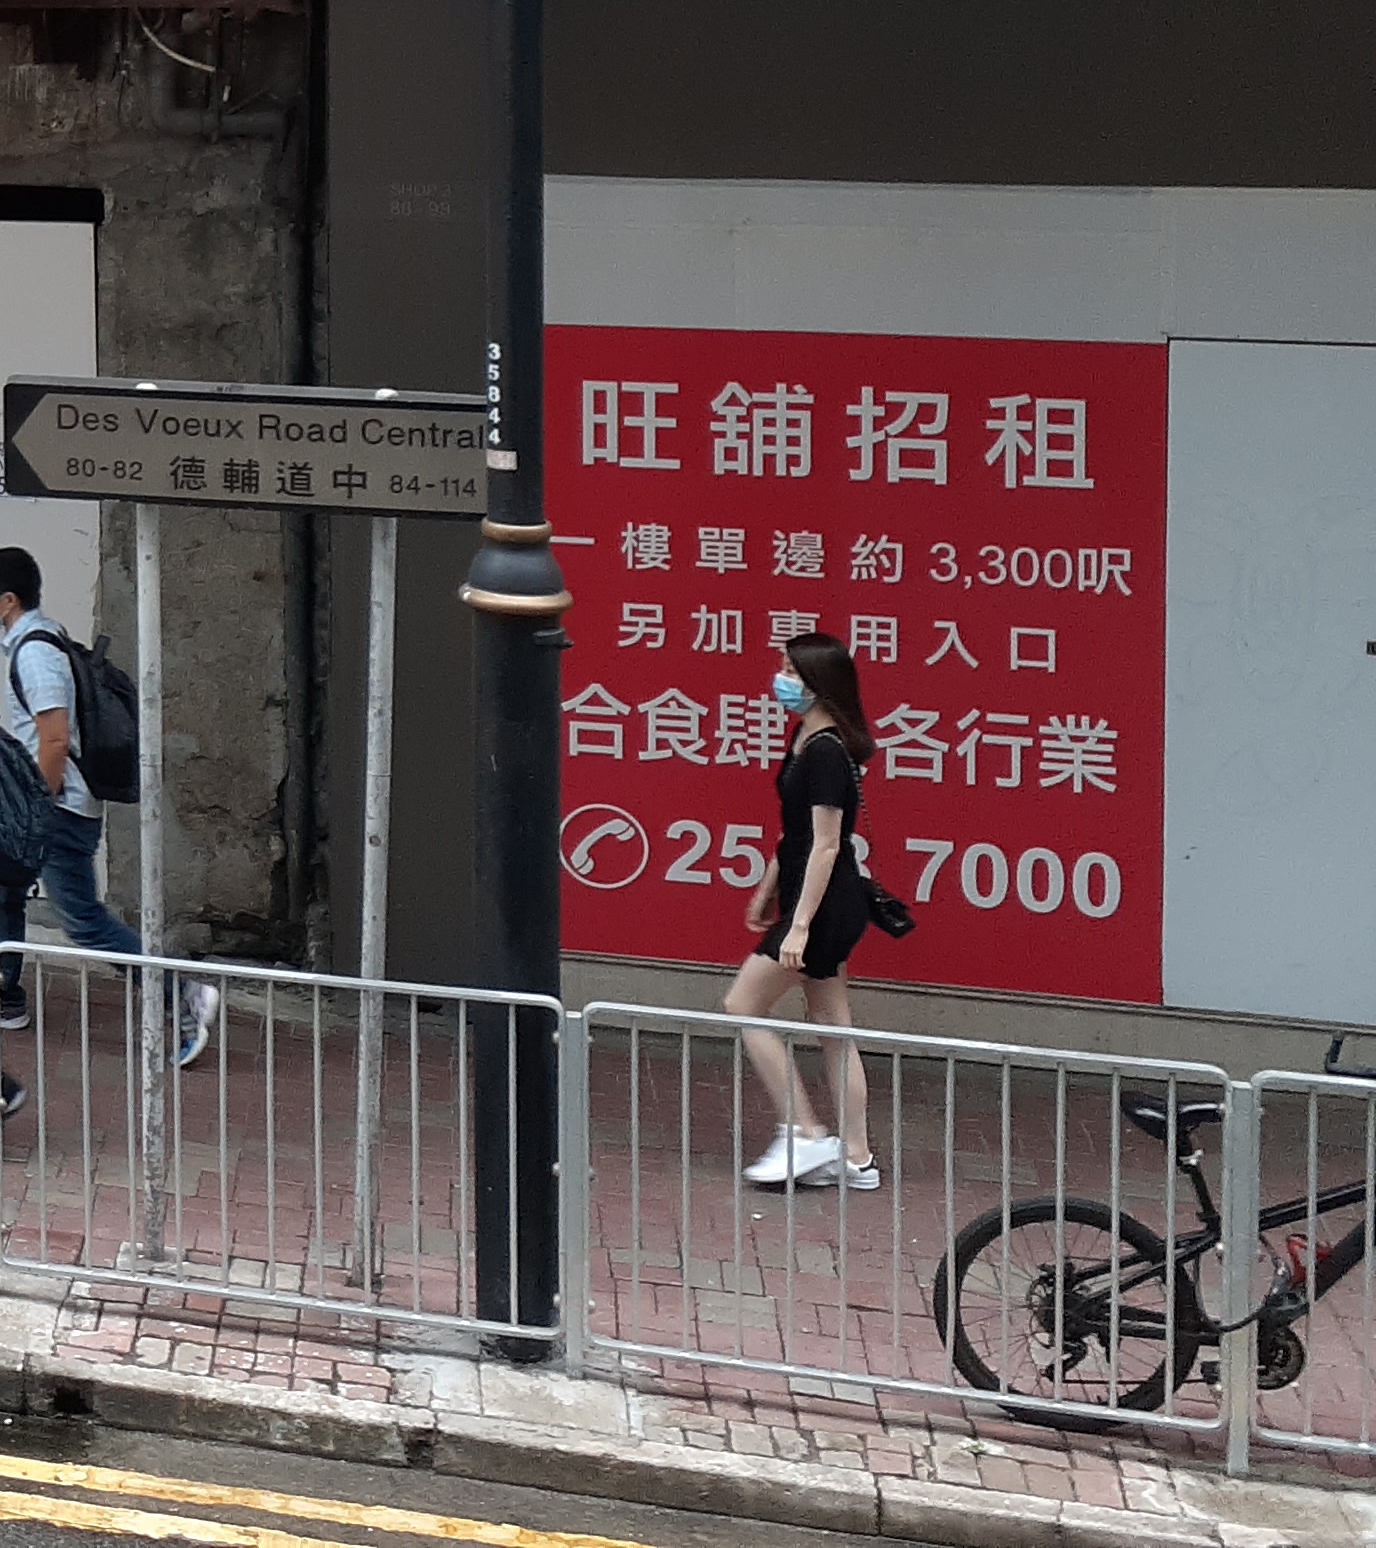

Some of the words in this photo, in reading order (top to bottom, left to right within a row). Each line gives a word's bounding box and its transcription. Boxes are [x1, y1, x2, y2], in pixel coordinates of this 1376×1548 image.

[56, 404, 118, 433] Des
[136, 408, 244, 440] Voeux
[258, 414, 346, 443] Road
[360, 418, 483, 449] Central
[488, 342, 501, 445] 35844
[66, 457, 142, 481] 80-82
[170, 455, 368, 499] 德輔道中
[389, 475, 477, 498] 84-114
[560, 683, 1119, 794] 合食肆各行業
[905, 839, 1120, 918] 7000
